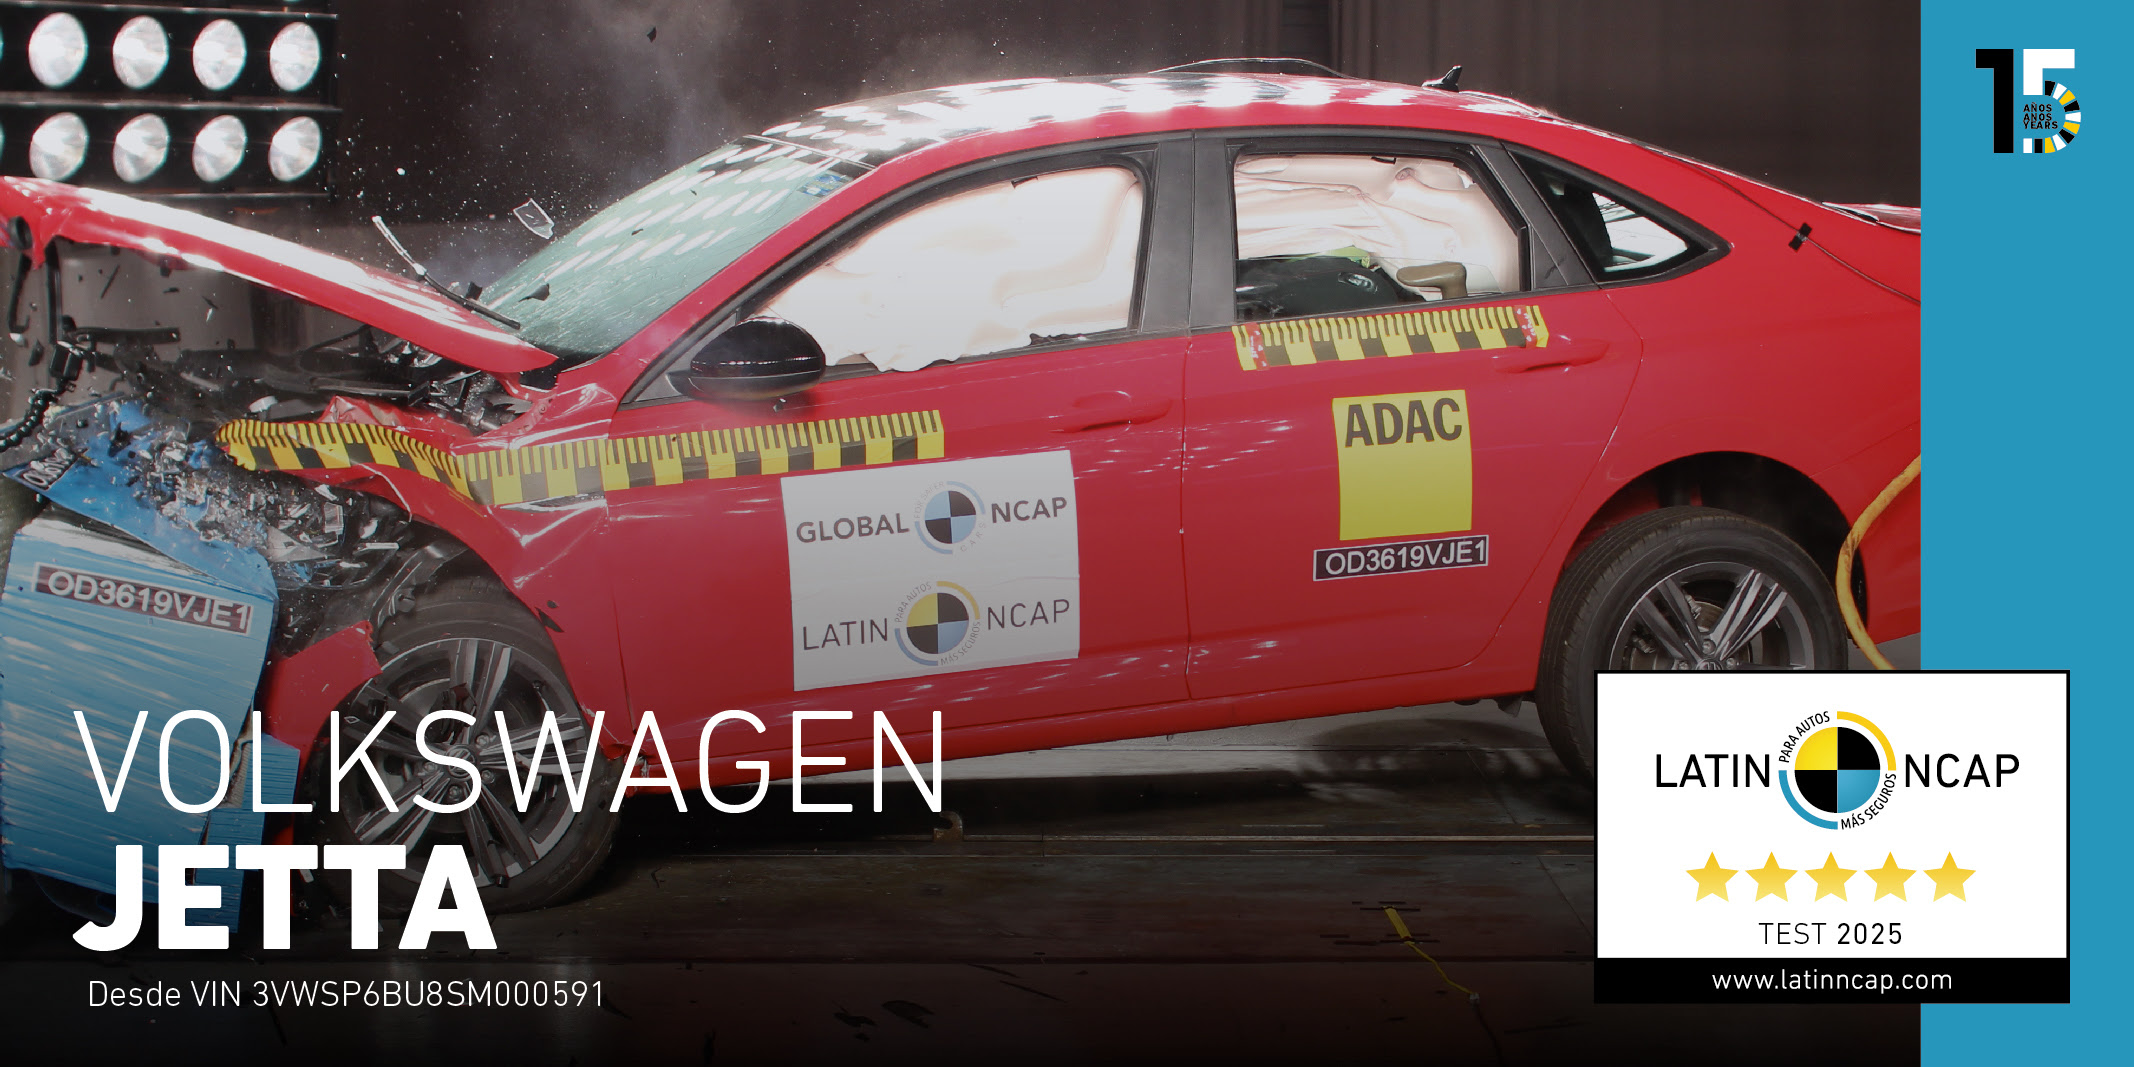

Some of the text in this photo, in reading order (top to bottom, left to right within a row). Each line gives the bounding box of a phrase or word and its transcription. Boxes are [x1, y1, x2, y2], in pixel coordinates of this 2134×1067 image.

[1345, 398, 1463, 448] ADAC
[796, 496, 1068, 543] GLOBAL NCAP
[1325, 539, 1485, 575] OD3619VJE1
[48, 571, 248, 630] OD3619VJE1
[895, 582, 932, 623] PARA AUTOS
[802, 599, 1071, 650] LATIN NCAP
[958, 621, 981, 657] SEGUROS
